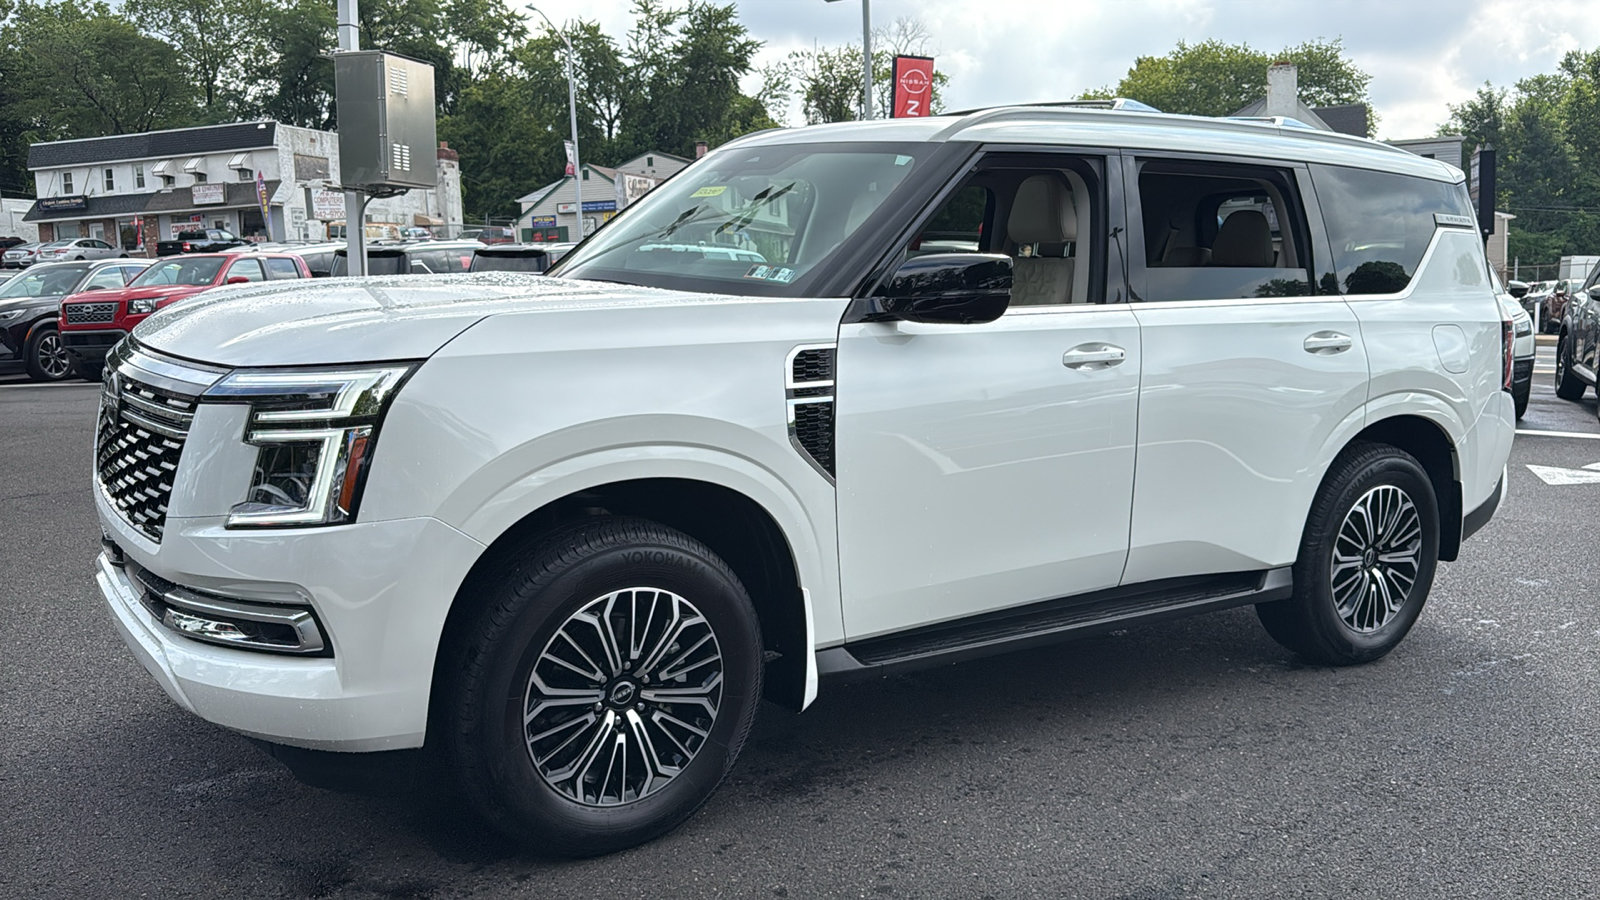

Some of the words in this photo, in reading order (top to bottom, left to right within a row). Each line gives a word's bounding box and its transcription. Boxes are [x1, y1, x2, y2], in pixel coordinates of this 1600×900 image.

[899, 78, 930, 86] NISSAN
[314, 196, 344, 204] COMPUTERS
[620, 550, 707, 574] YOKOHAMA
